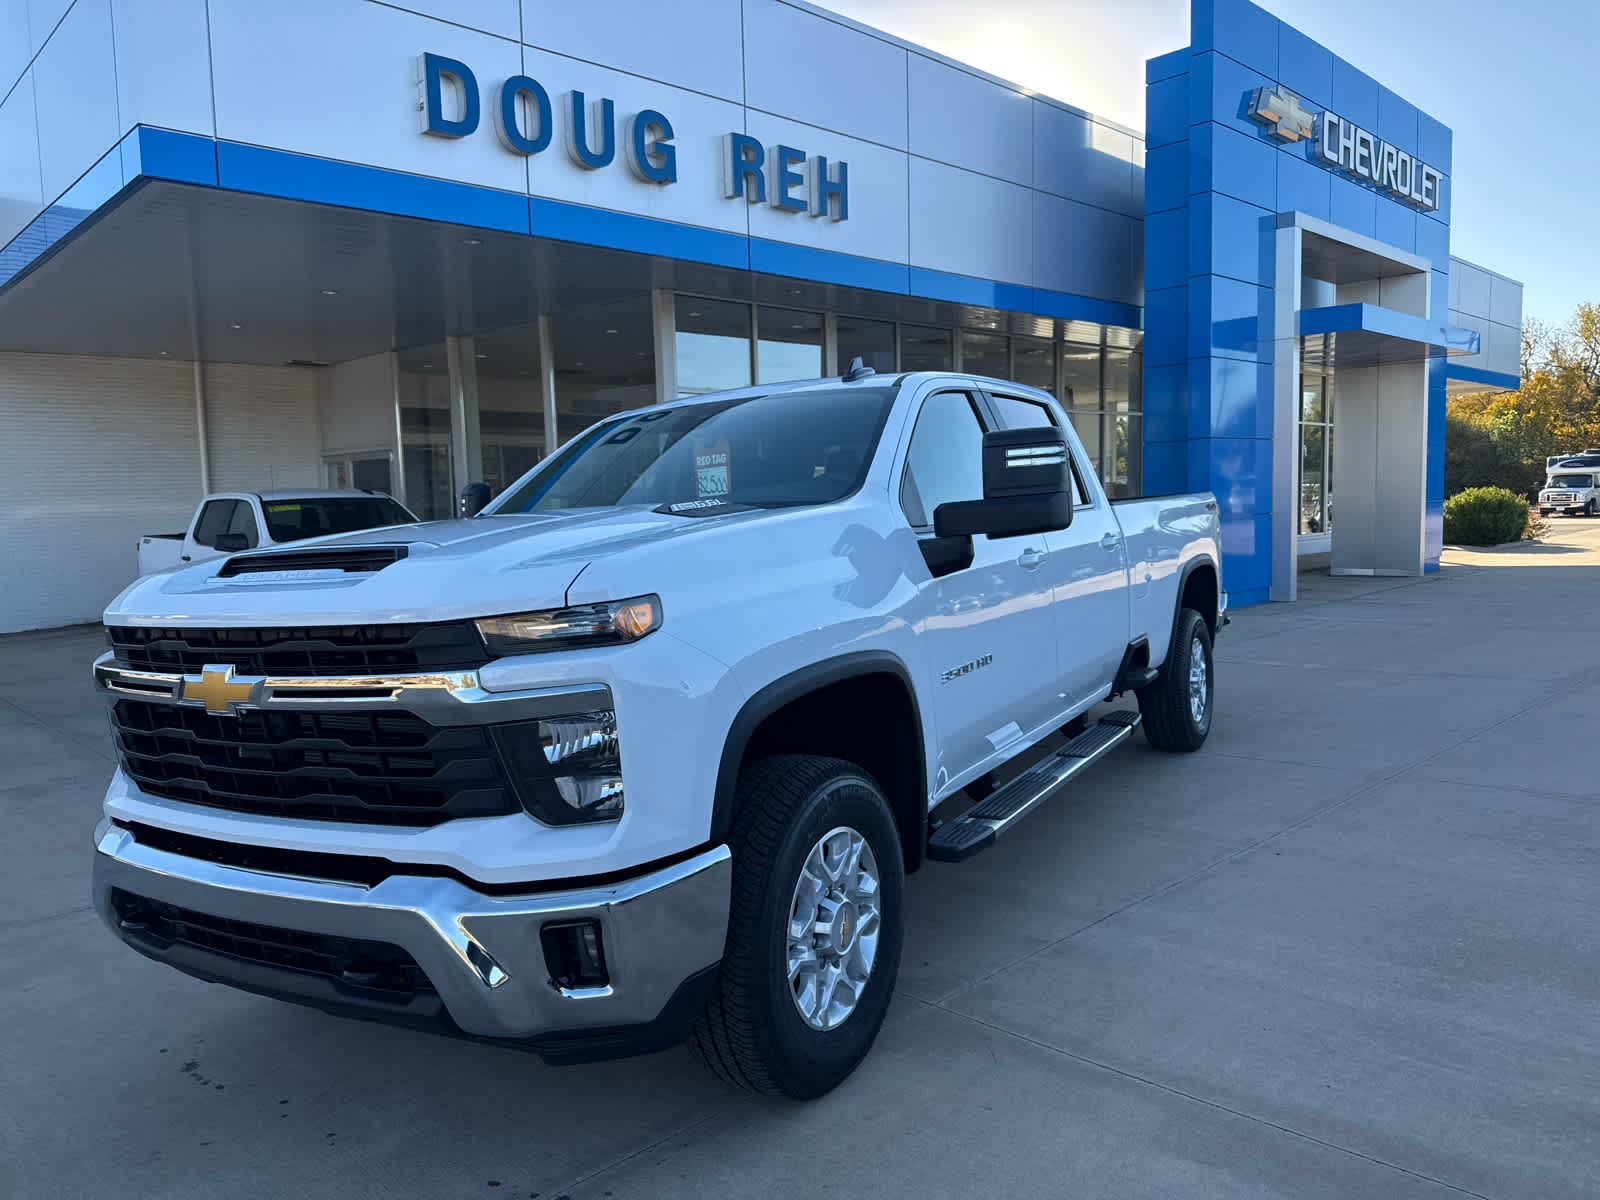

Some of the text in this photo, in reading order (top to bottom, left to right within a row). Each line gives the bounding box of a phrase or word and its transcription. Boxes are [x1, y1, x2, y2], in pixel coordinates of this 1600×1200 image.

[420, 52, 849, 221] DOUG REH
[1322, 110, 1444, 211] CHEVROLET
[696, 453, 727, 466] RED TAG
[941, 653, 992, 684] 3500 HD
